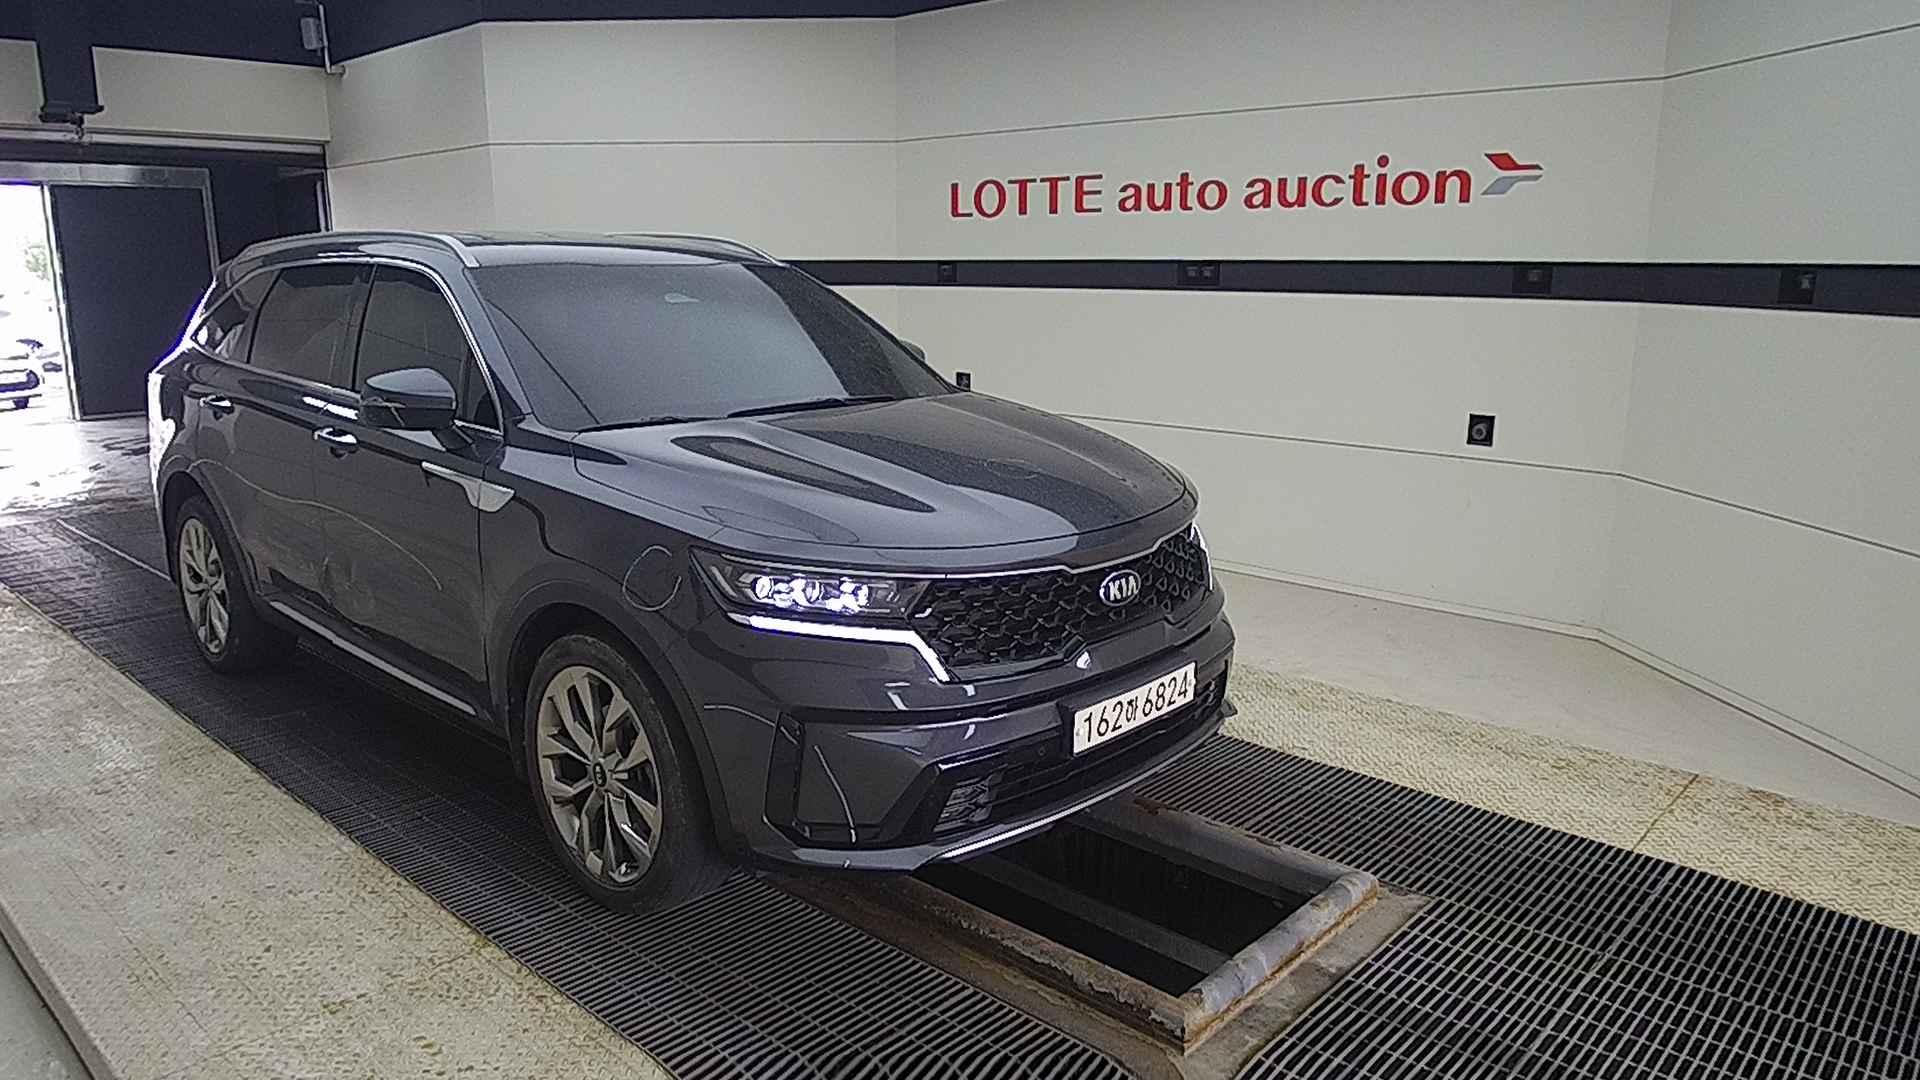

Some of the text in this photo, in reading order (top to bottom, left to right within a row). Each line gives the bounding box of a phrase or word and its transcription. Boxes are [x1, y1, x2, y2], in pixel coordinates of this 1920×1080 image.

[950, 154, 1473, 218] LOTTE auto auction
[1108, 575, 1138, 601] KIA
